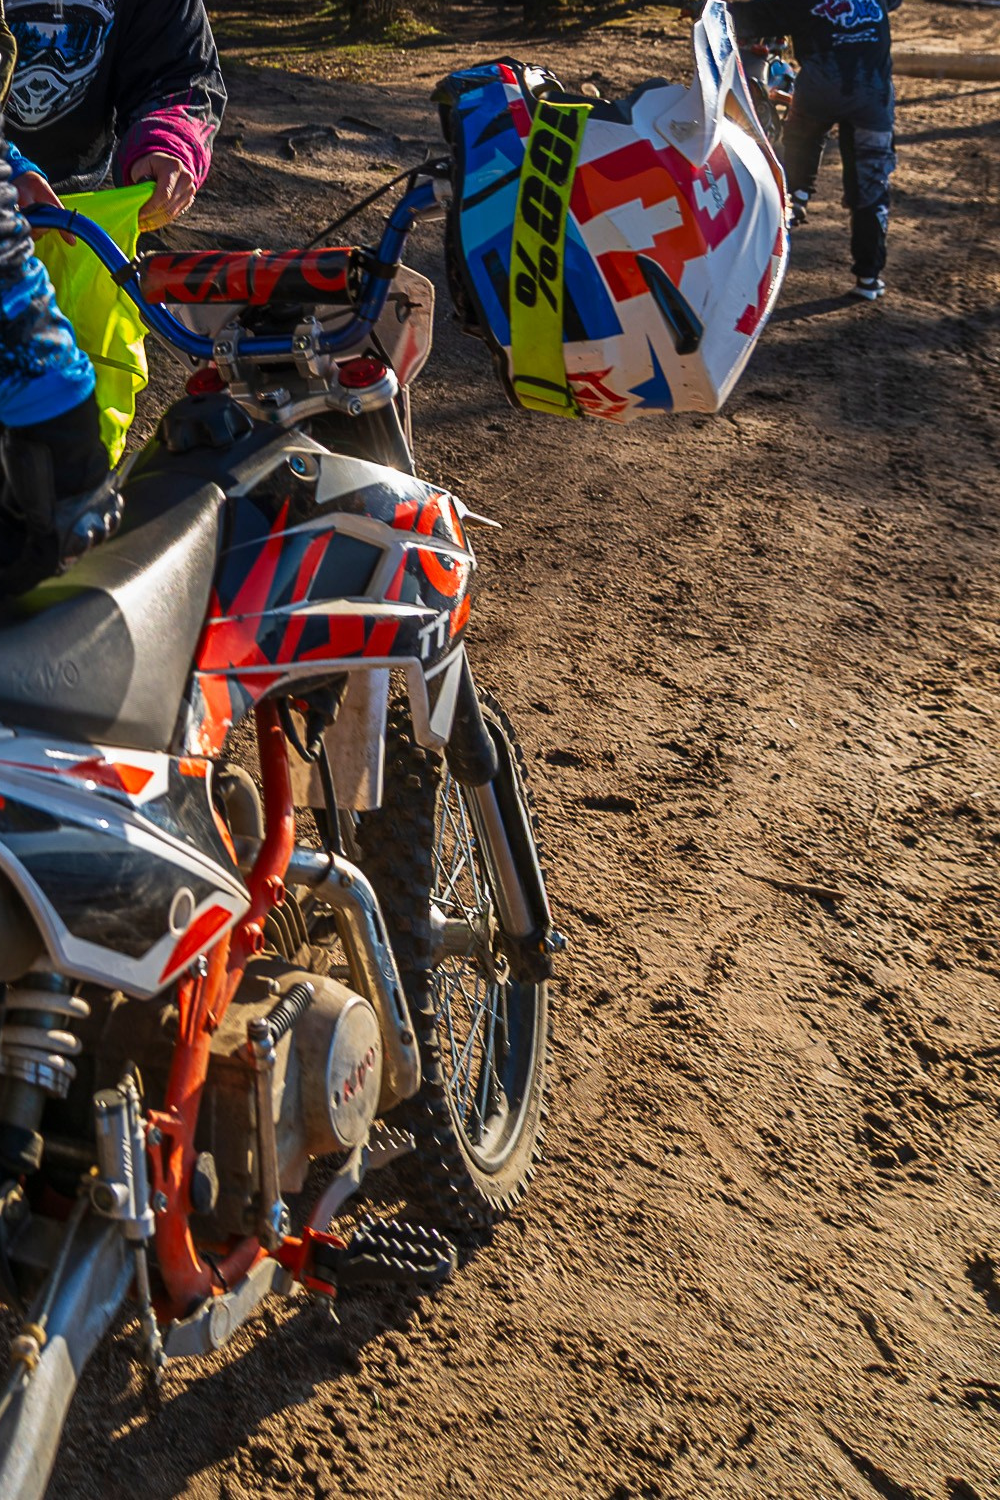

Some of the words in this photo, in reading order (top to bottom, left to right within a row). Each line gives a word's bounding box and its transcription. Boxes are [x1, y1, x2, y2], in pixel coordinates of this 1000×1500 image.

[514, 103, 579, 314] 100%
[145, 247, 352, 306] KAYO
[418, 608, 450, 661] TT
